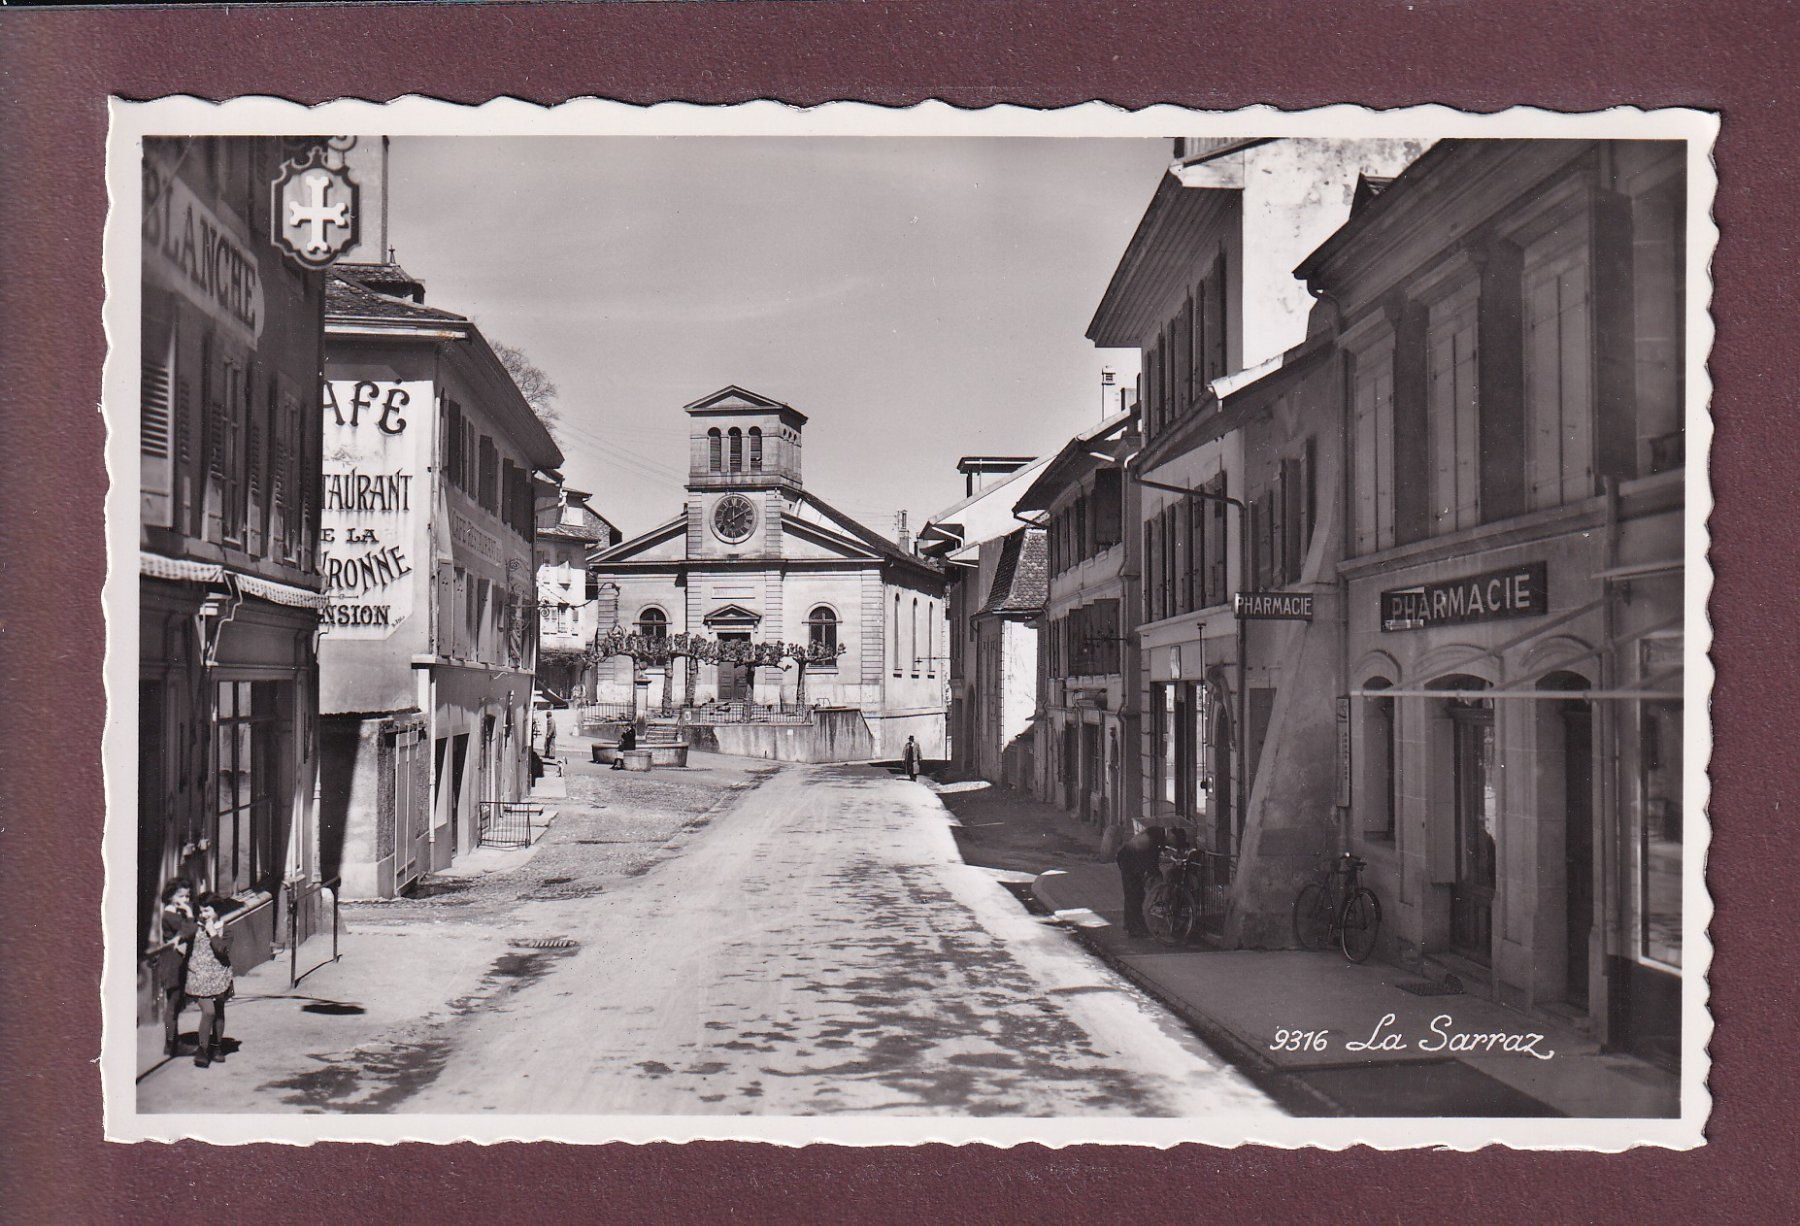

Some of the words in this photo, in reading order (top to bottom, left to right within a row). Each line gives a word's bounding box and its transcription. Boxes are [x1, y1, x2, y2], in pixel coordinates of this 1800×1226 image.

[142, 166, 256, 331] BLANCHE
[346, 528, 379, 543] LA
[1237, 596, 1313, 617] PHARMACIE
[1390, 574, 1531, 620] PHARMACIE
